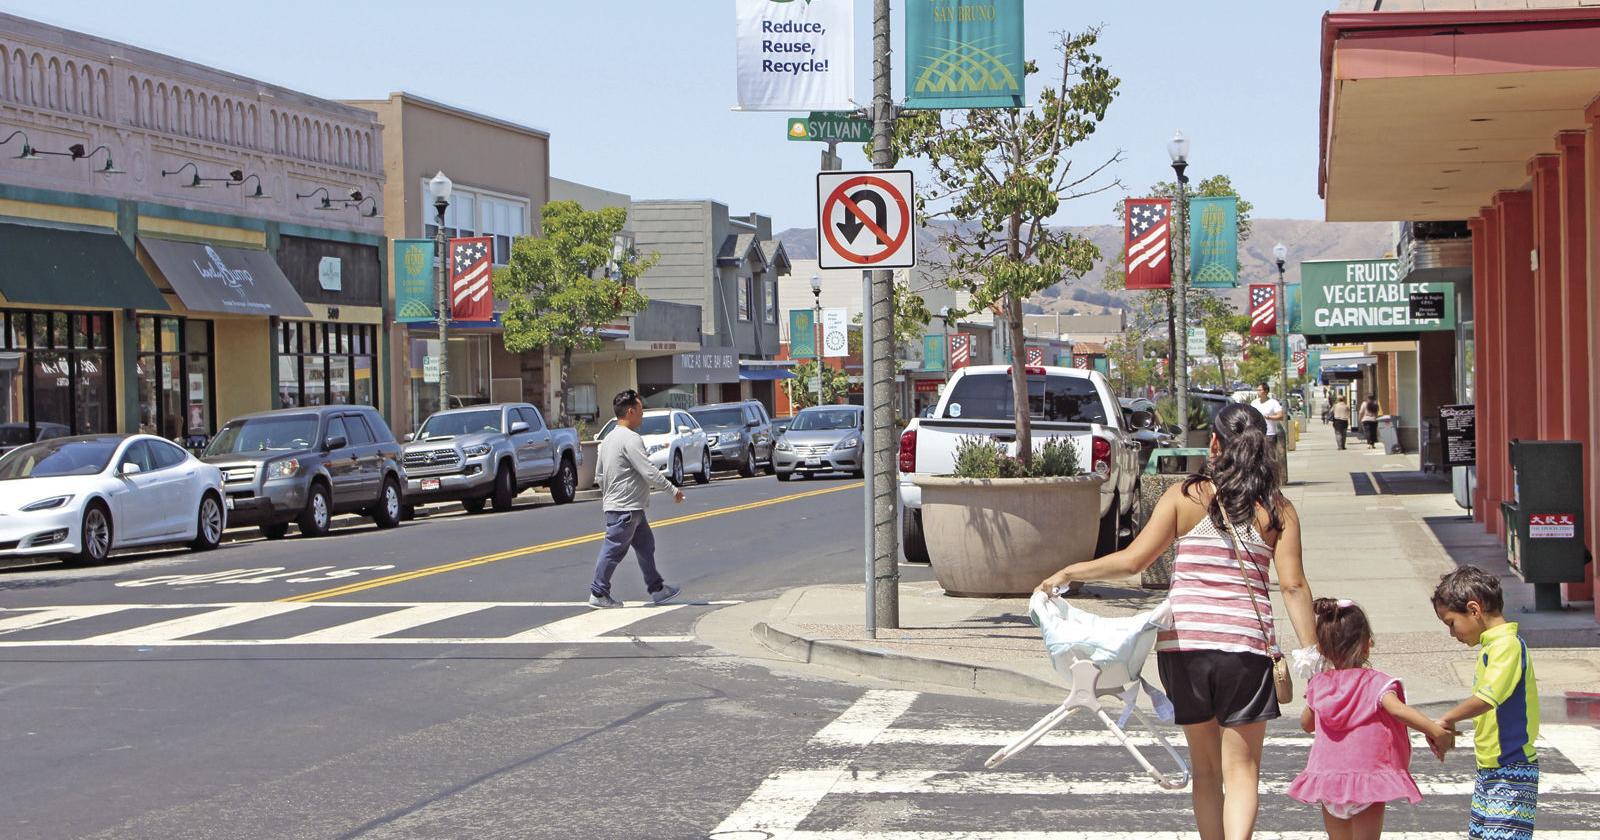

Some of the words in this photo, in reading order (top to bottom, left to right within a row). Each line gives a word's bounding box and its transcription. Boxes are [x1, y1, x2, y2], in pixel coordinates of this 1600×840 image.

[933, 6, 954, 22] SAN
[958, 5, 997, 22] BRUNO
[762, 20, 826, 36] Reduce,
[762, 40, 816, 55] Reuse,
[762, 59, 829, 75] Recycle!
[808, 121, 861, 139] SYLVAN
[1346, 263, 1398, 282] FRUITS
[1323, 282, 1429, 304] VEGETABLES
[681, 354, 695, 369] TWICE
[702, 354, 713, 369] NICE
[722, 354, 734, 369] AREA
